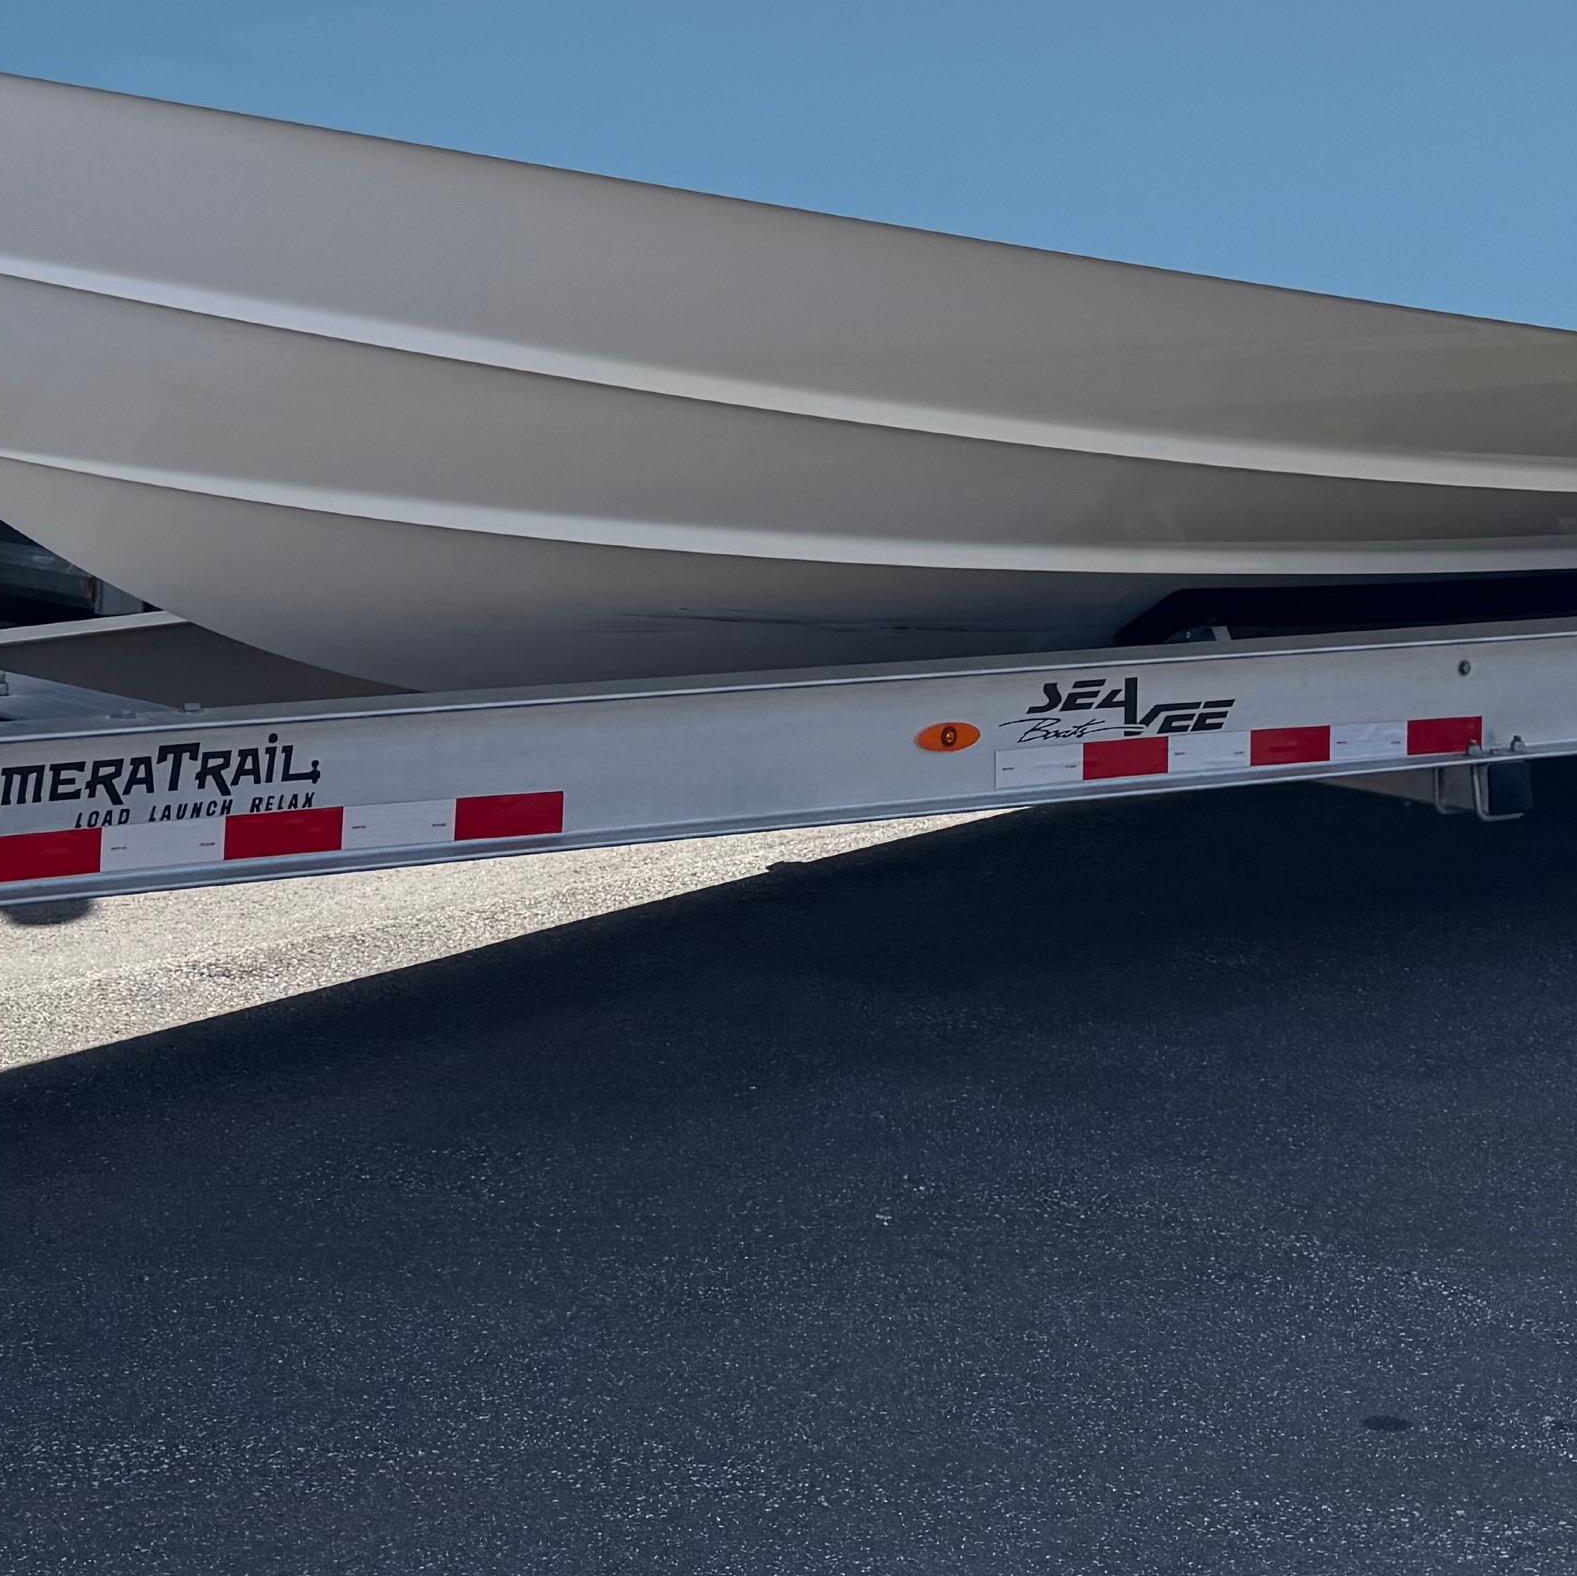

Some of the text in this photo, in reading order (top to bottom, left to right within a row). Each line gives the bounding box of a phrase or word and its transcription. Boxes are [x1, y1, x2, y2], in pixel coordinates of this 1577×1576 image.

[1026, 677, 1235, 736] SEA VEE
[75, 791, 316, 829] LOAD LAUNCH RELAX
